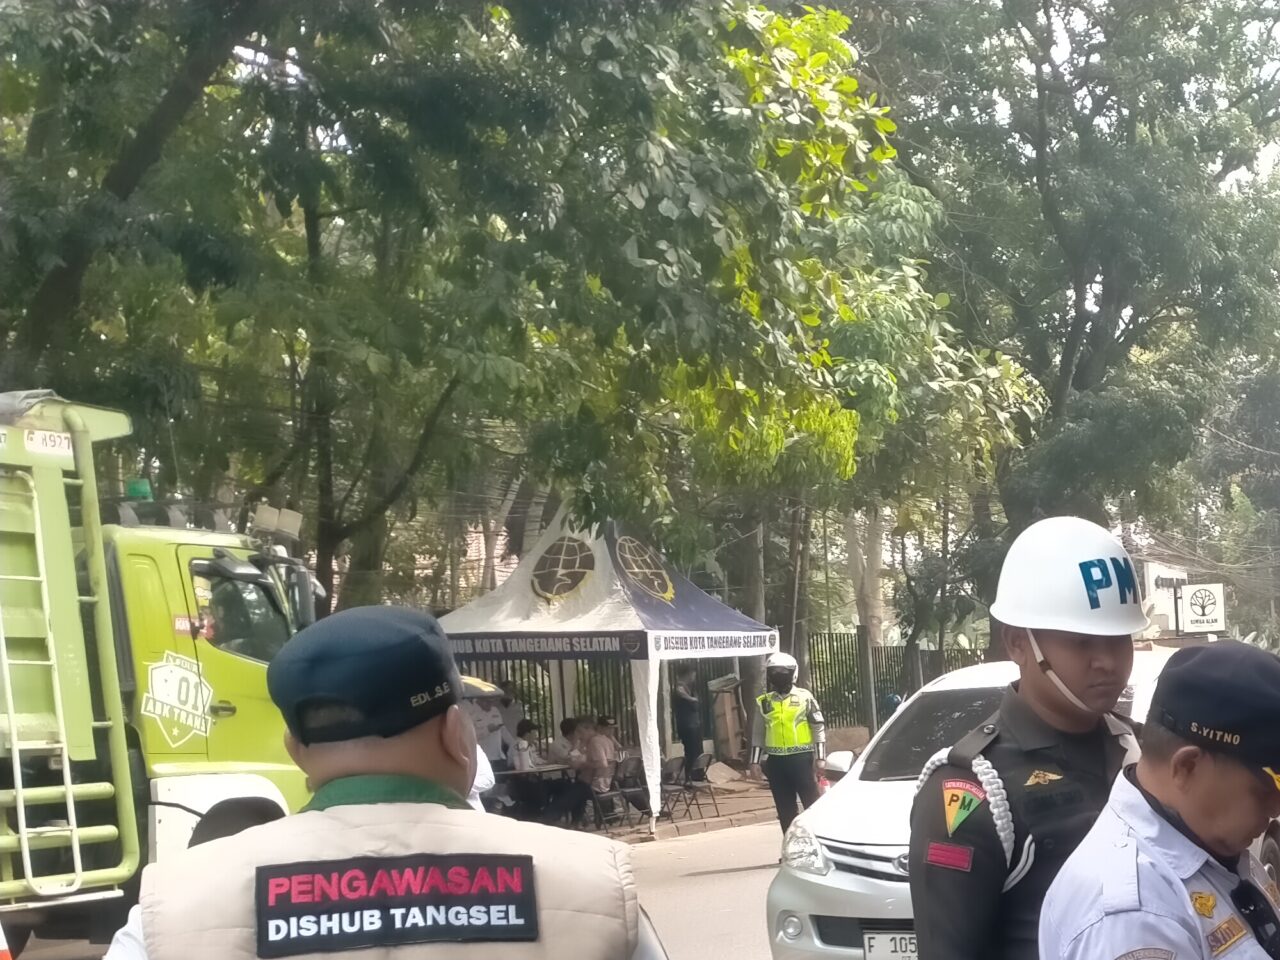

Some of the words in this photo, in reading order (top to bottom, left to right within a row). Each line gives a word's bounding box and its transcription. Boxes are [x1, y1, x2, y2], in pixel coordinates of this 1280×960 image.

[1078, 556, 1138, 610] PM
[475, 637, 504, 653] KOTA
[505, 637, 571, 652] TANGERANG
[572, 636, 620, 652] SELATAN
[664, 636, 689, 651] DISHUB
[690, 636, 706, 650] KOTA
[706, 635, 742, 649] TANGERANG
[743, 634, 767, 648] SELATAN
[1190, 721, 1241, 745] S.YITNO
[947, 793, 974, 812] PM
[267, 866, 523, 907] PENGAWASAN
[267, 909, 383, 941] DISHUB
[390, 904, 525, 929] TANGSEL
[867, 936, 876, 953] F
